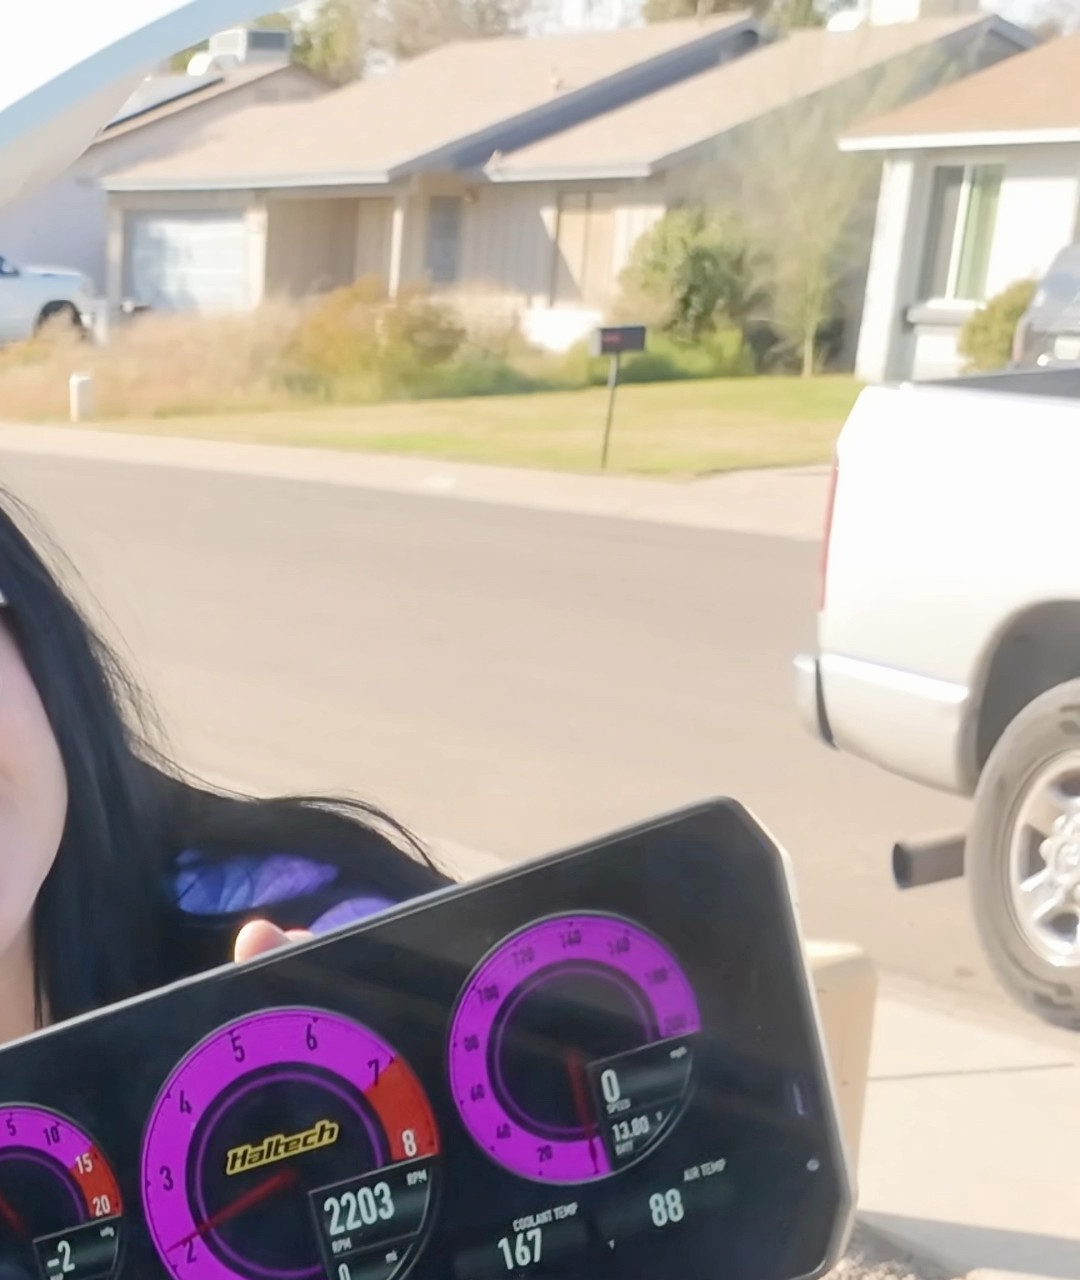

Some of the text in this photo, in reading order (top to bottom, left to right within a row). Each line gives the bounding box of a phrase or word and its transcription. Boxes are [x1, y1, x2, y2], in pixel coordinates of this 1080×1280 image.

[231, 1035, 245, 1062] 5
[306, 1023, 319, 1051] 6
[368, 1059, 380, 1086] 7
[601, 1068, 621, 1104] 0
[179, 1090, 192, 1115] 4
[6, 1118, 17, 1136] 5
[43, 1125, 61, 1146] 10
[227, 1120, 339, 1175] Haltech
[401, 1129, 417, 1157] 8
[75, 1153, 94, 1175] 15
[700, 1158, 727, 1178] TEMP
[159, 1166, 174, 1191] 3
[92, 1194, 111, 1217] 20
[323, 1181, 395, 1236] 2203
[553, 1201, 579, 1222] TEMP
[649, 1188, 685, 1227] 88
[47, 1240, 75, 1273] -2
[183, 1239, 198, 1264] 2
[497, 1227, 542, 1270] 167
